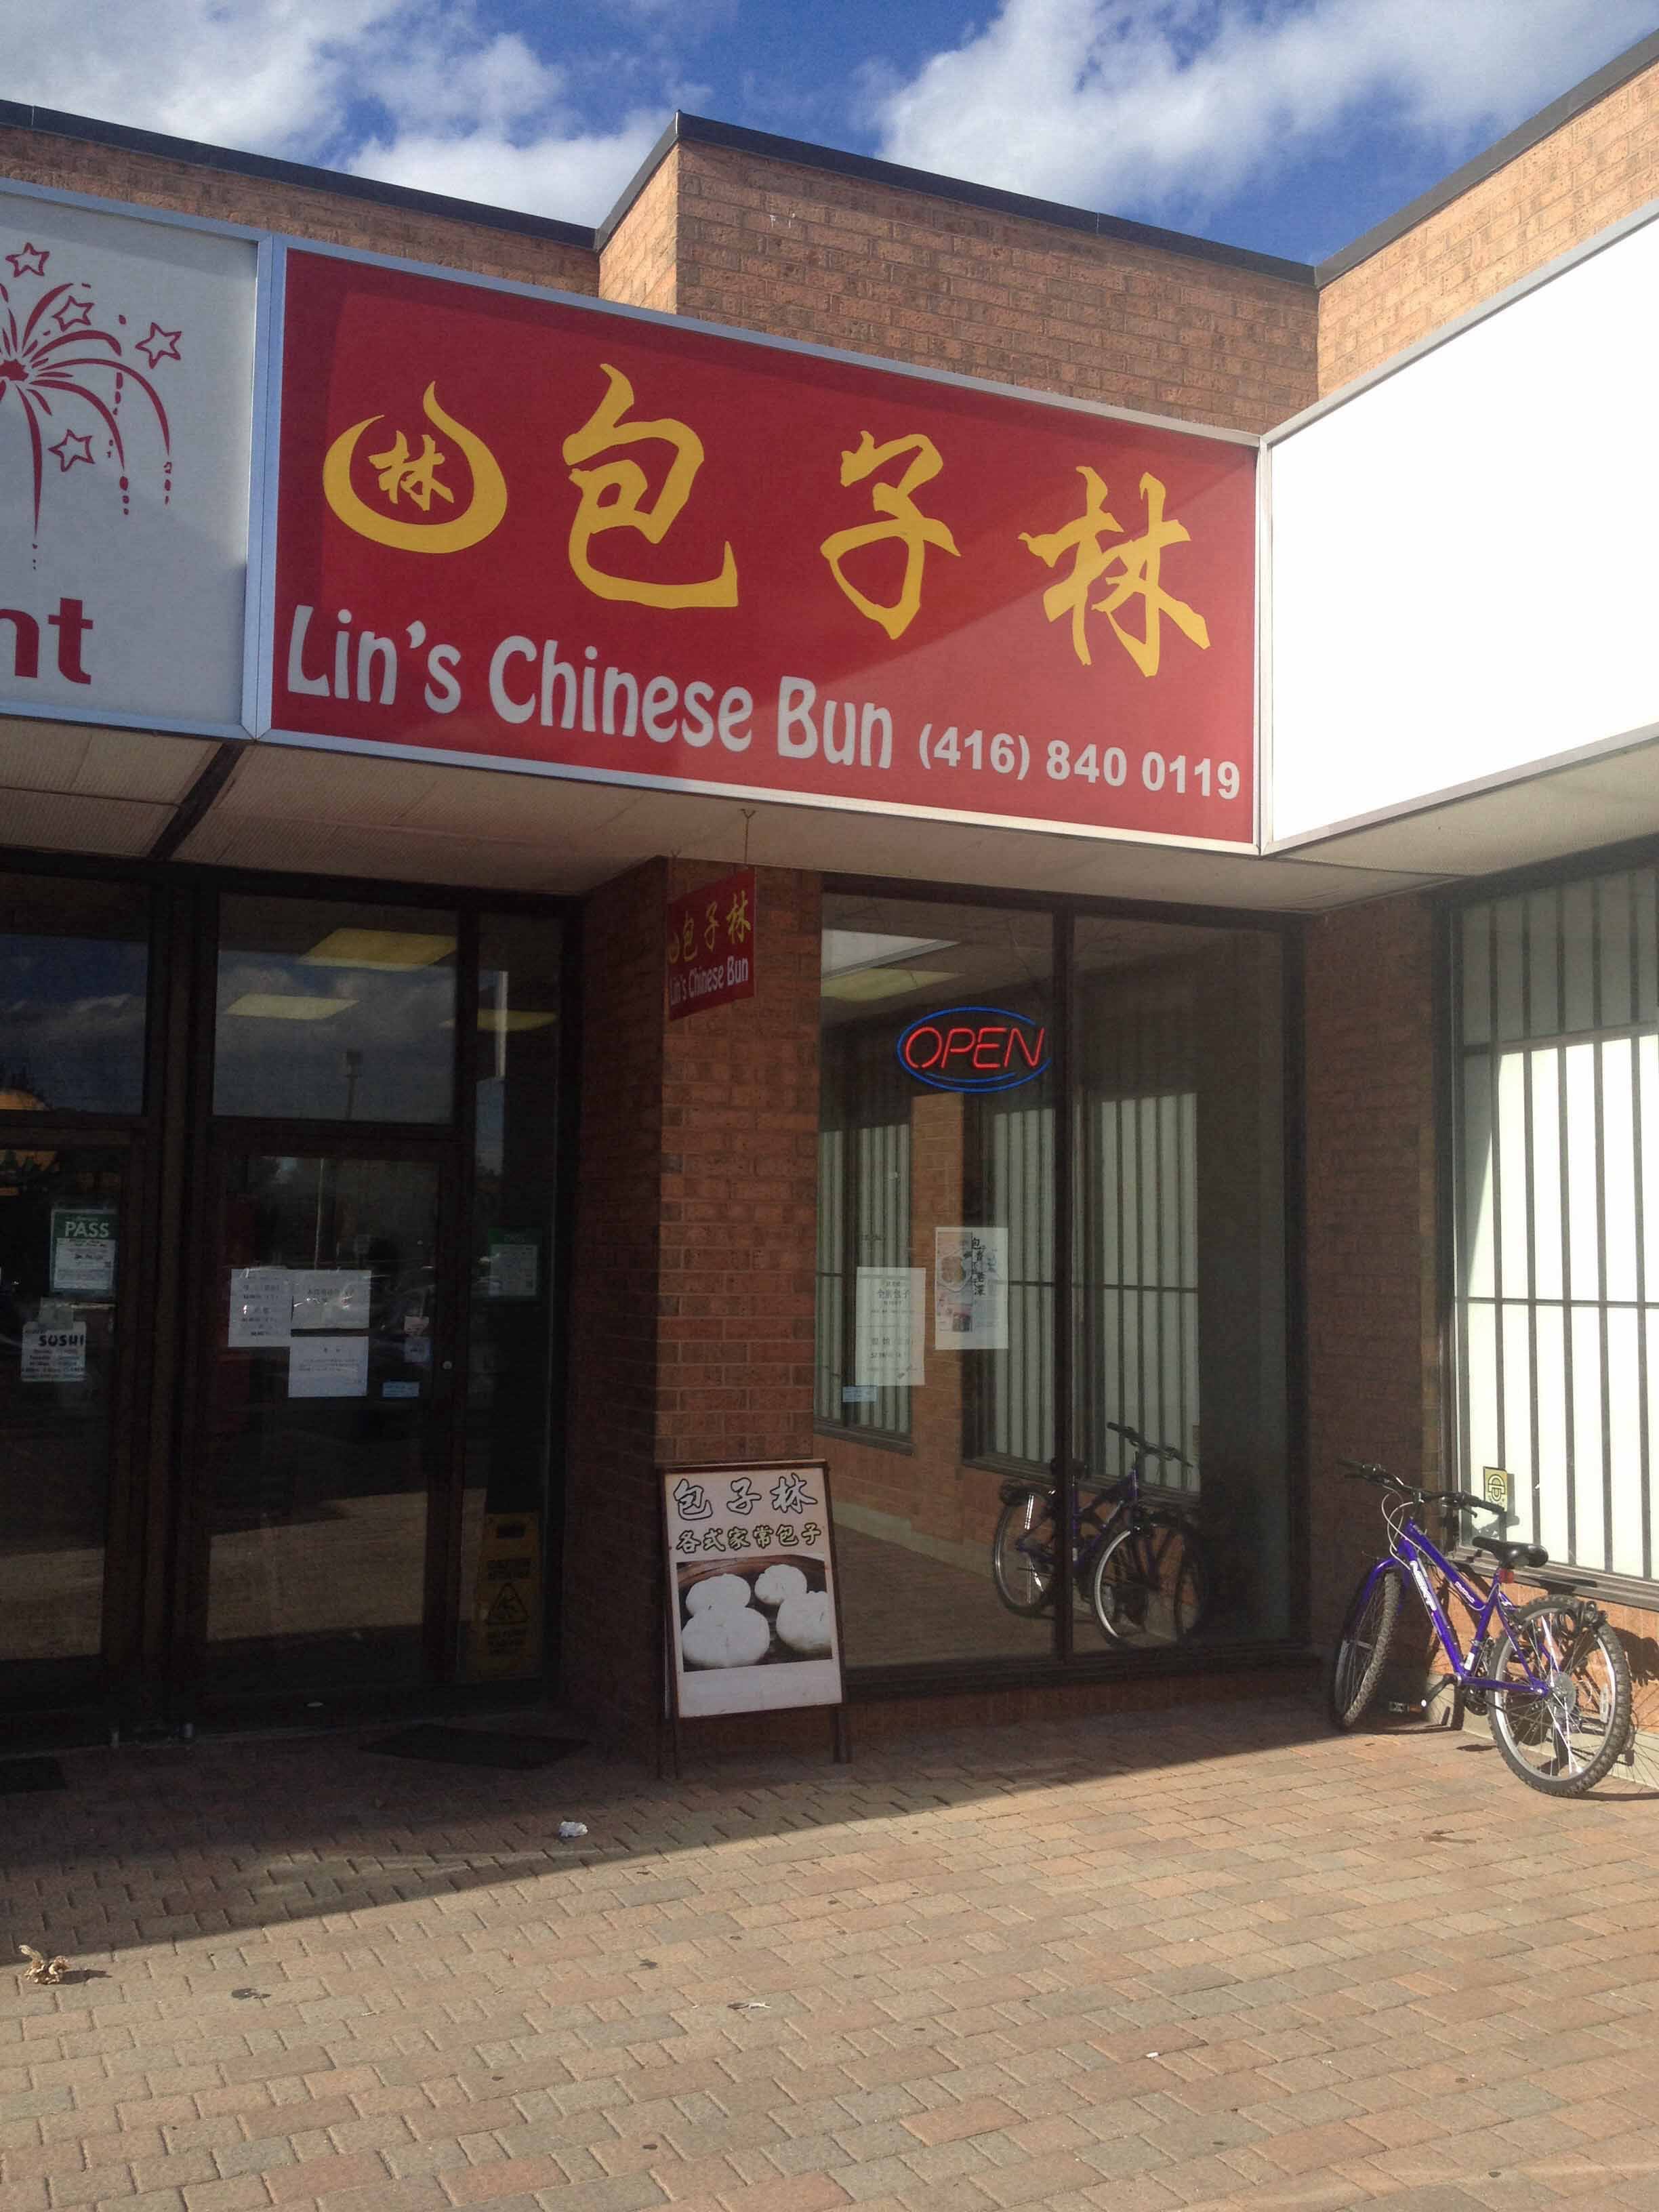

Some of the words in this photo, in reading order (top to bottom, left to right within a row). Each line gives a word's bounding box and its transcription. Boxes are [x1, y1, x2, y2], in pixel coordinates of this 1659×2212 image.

[368, 430, 453, 511] 林
[562, 363, 1211, 678] 包子林
[287, 605, 462, 714] Lin's
[489, 635, 753, 752] Chinese
[777, 676, 893, 769] Bun
[918, 723, 1030, 780] (416)
[1046, 739, 1127, 786] 840
[1142, 752, 1240, 800] 0119
[682, 890, 751, 962] 包子林
[689, 965, 724, 998] Chinese
[726, 955, 749, 986] Bun
[905, 1025, 1045, 1069] OPEN
[64, 1221, 109, 1238] PASS
[38, 1334, 85, 1347] SUSHI
[673, 1473, 818, 1521] 包子林
[676, 1523, 821, 1554] 各式家常包子
